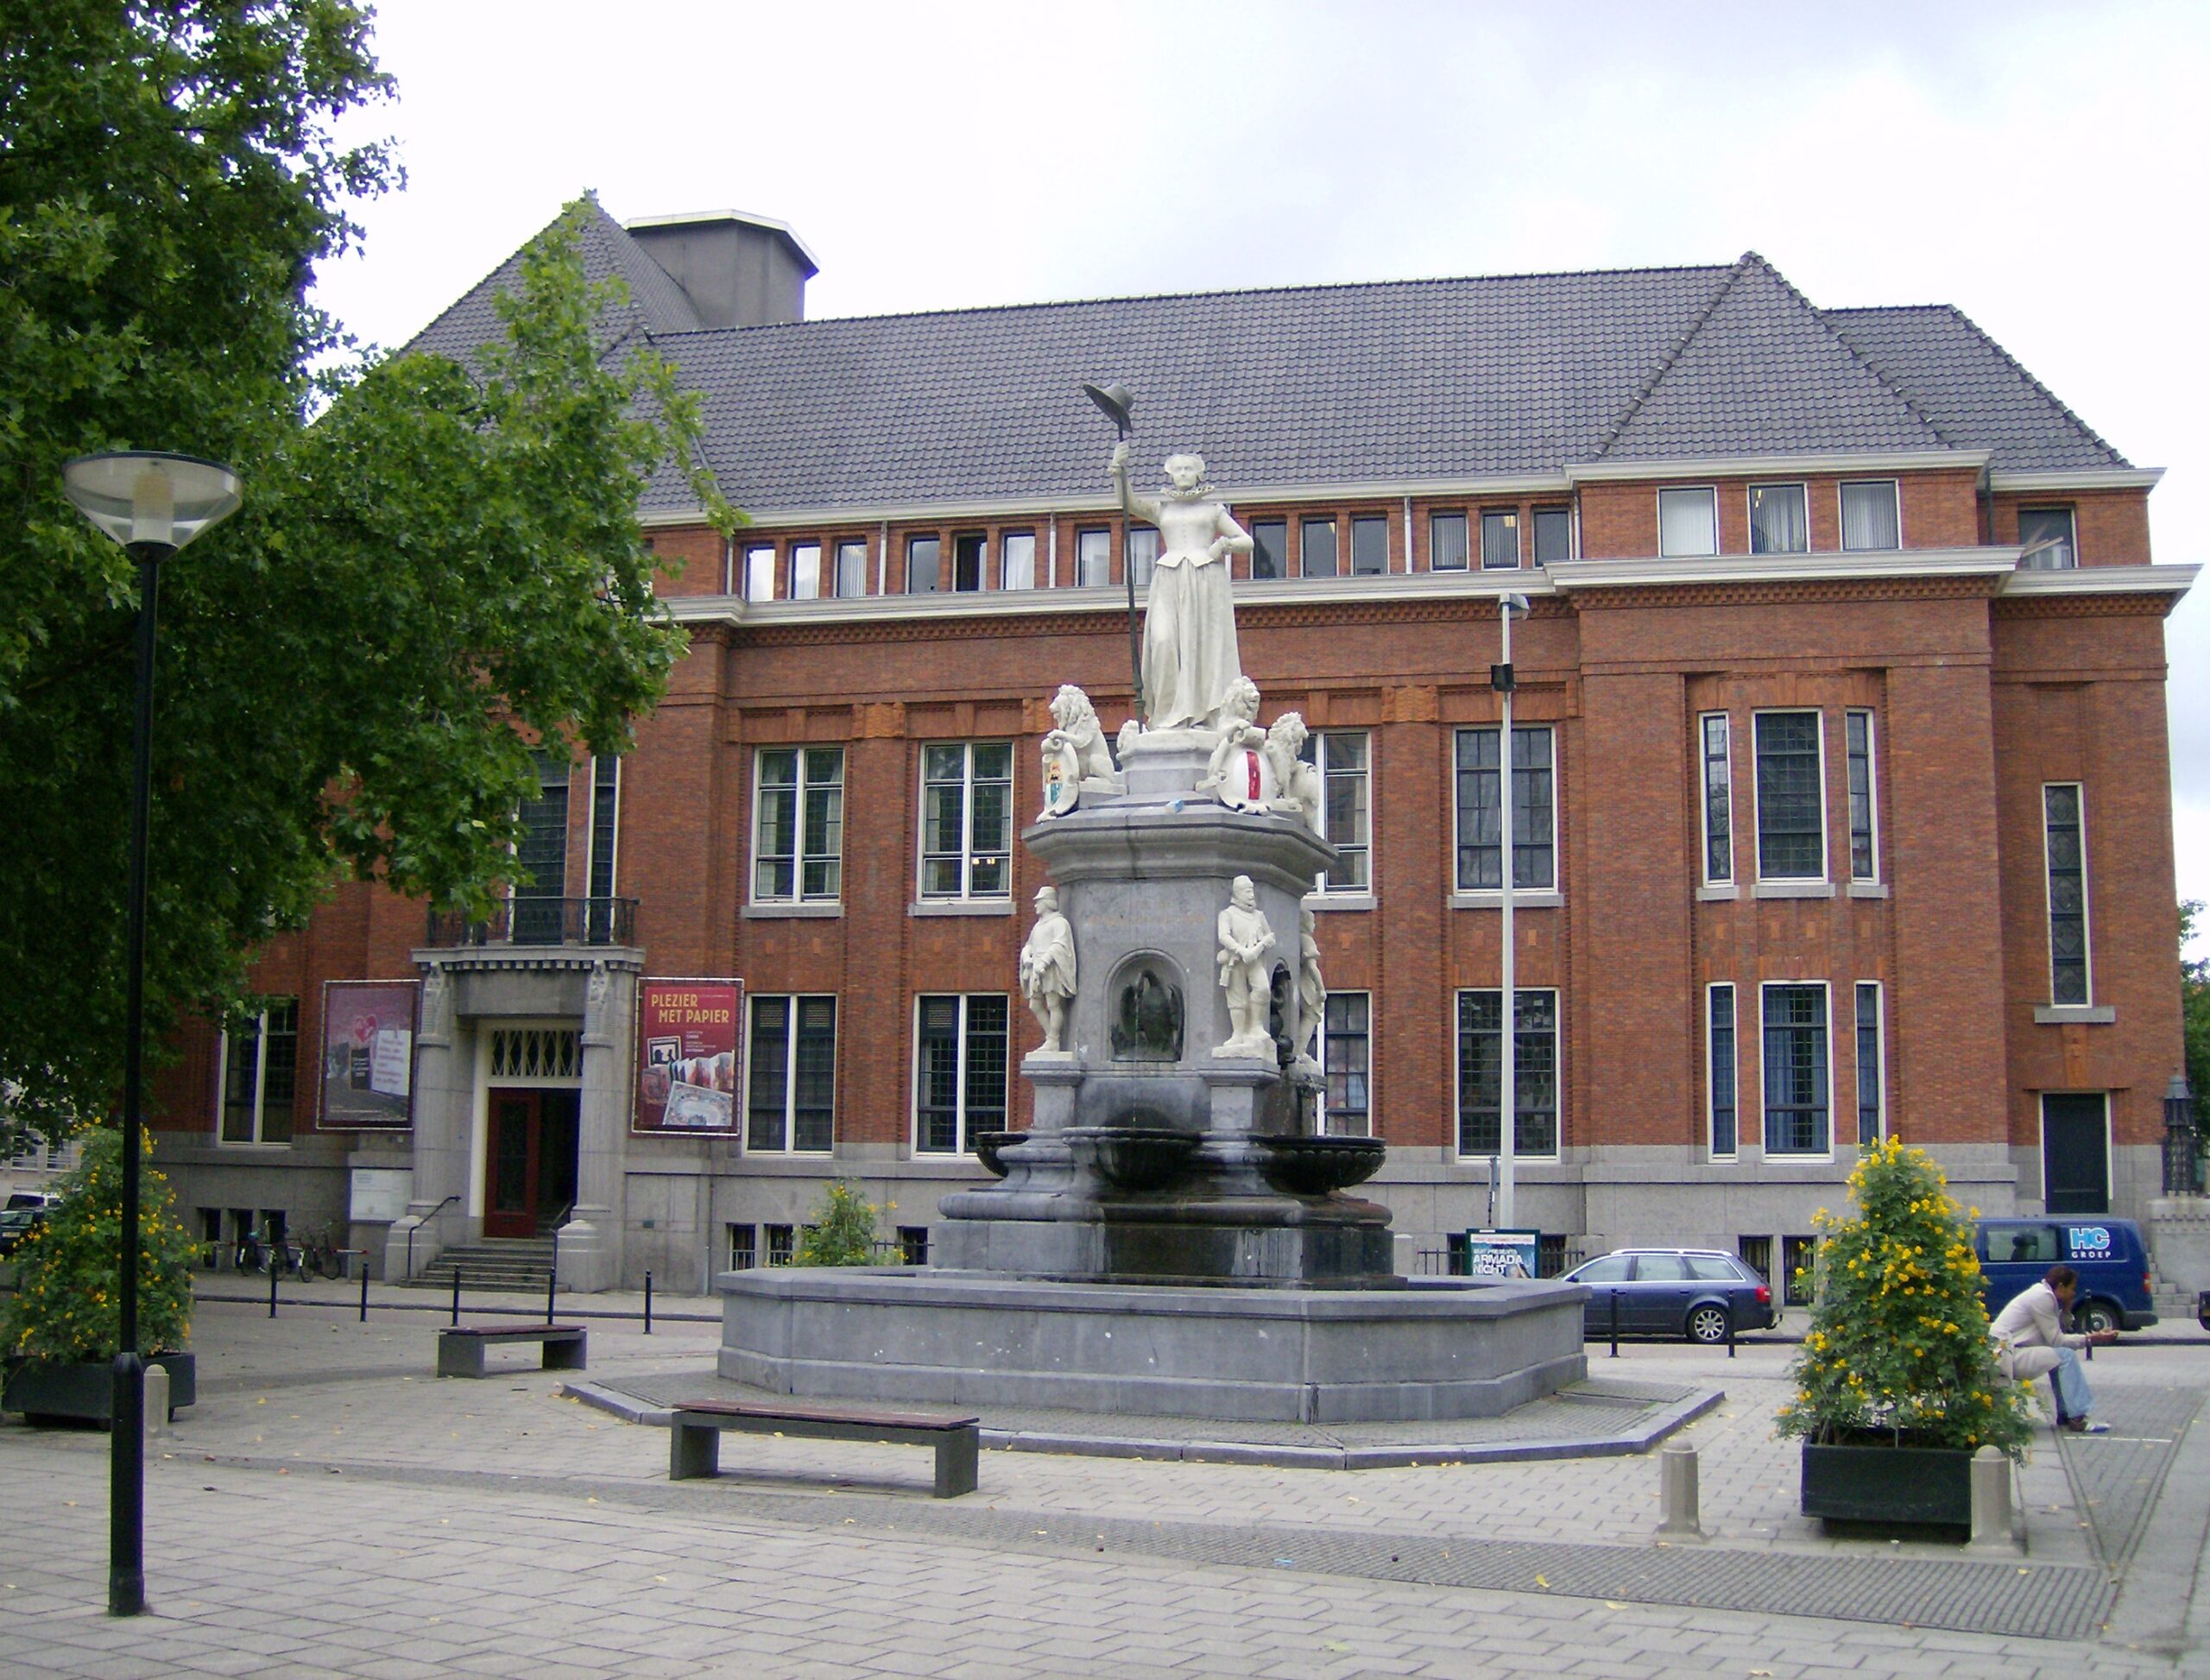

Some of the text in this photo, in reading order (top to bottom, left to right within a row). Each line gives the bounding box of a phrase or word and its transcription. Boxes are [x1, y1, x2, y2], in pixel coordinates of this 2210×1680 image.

[651, 994, 698, 1007] PLEZIER
[659, 1009, 729, 1023] MET PAPIER
[2069, 1227, 2111, 1249] HC
[1473, 1254, 1524, 1265] ARMADA
[1473, 1265, 1506, 1274] NIGHT
